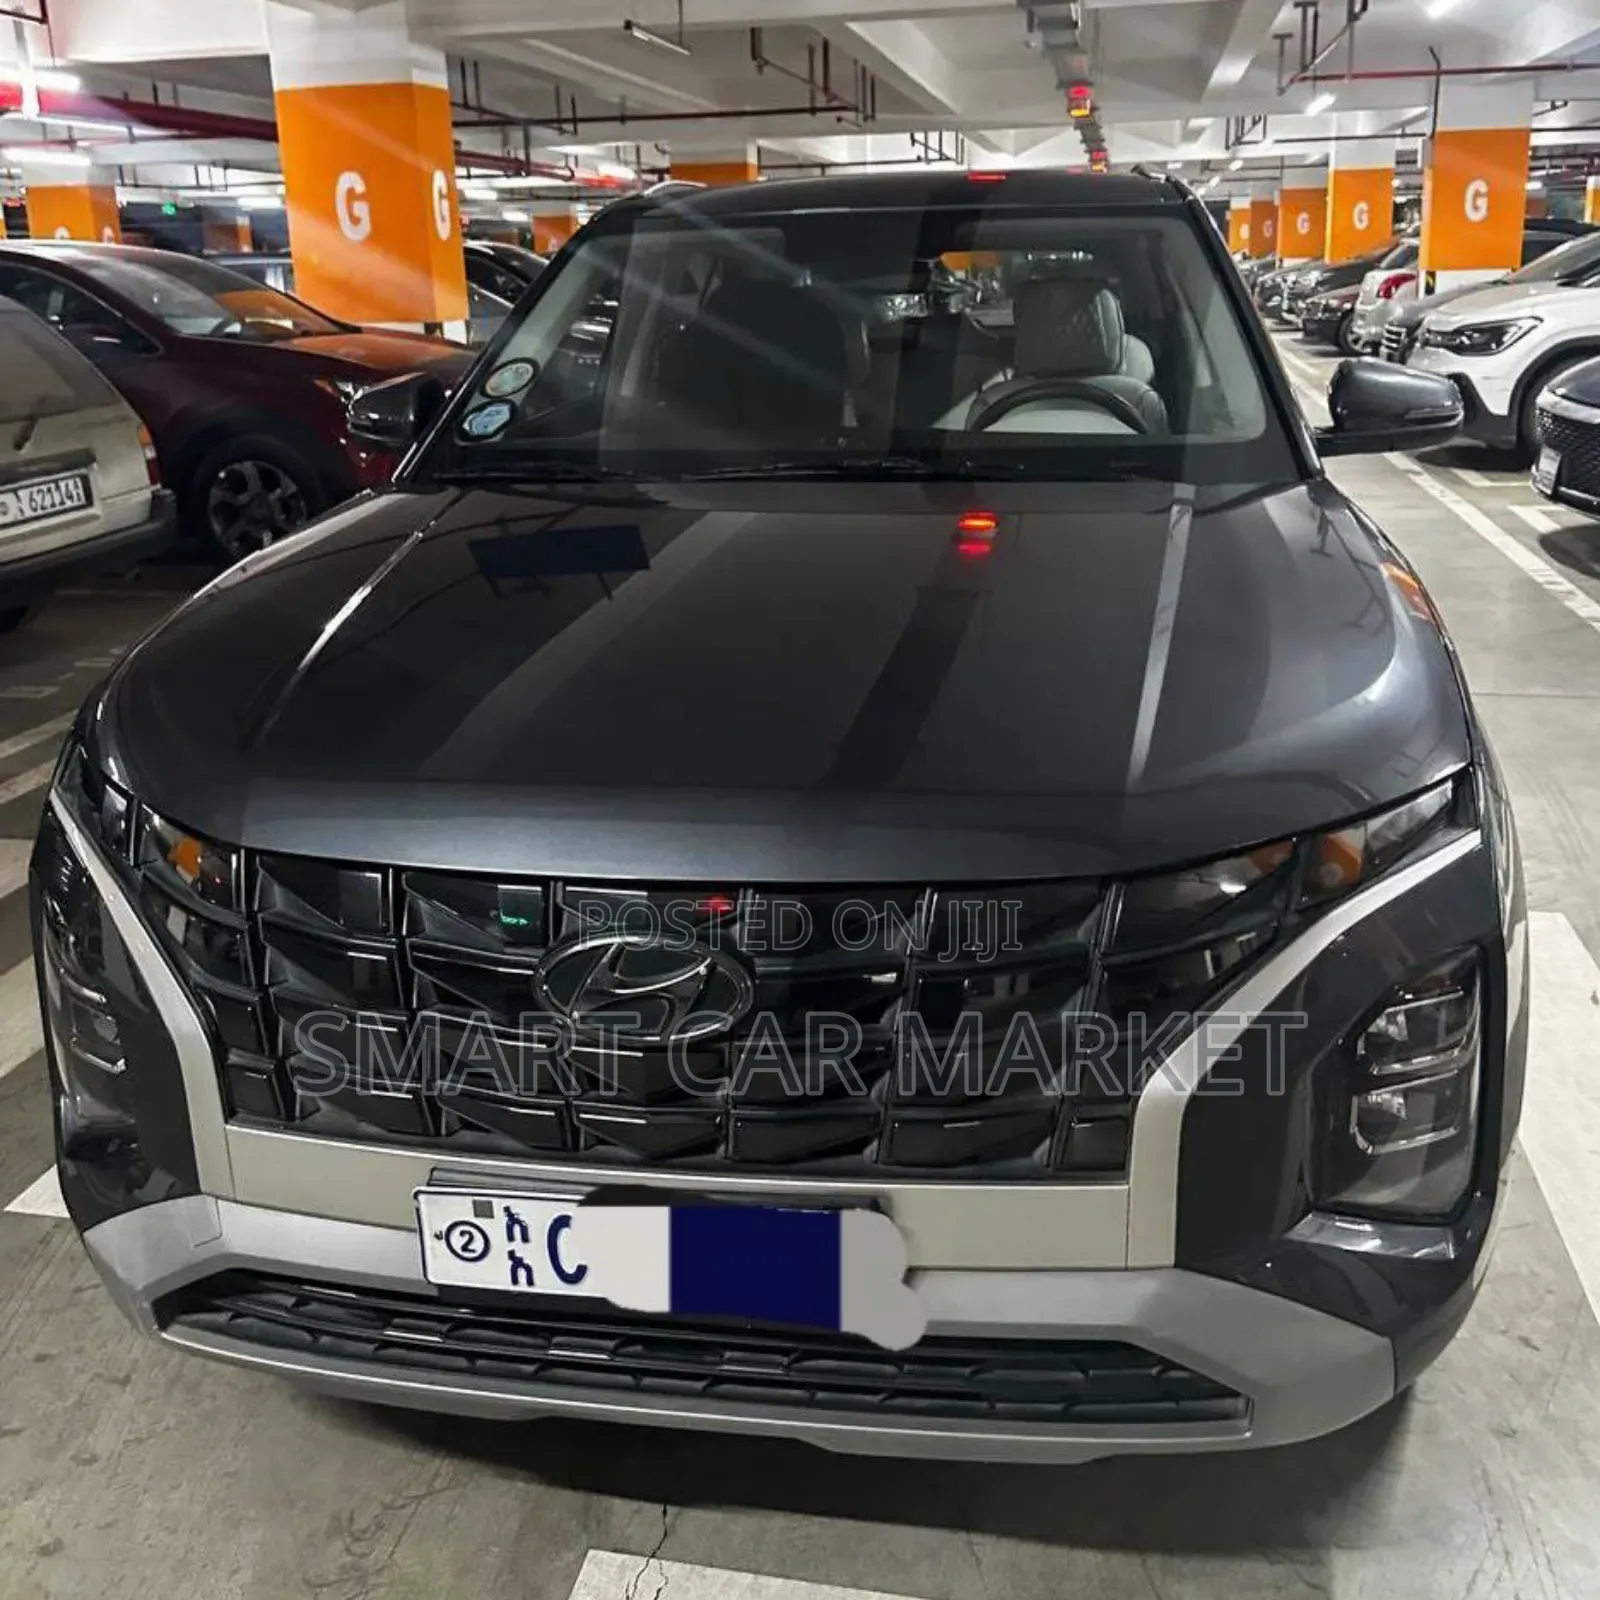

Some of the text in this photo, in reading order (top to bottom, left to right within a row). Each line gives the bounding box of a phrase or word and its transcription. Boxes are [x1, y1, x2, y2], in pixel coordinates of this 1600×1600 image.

[335, 171, 371, 243] G
[433, 169, 451, 242] G
[1353, 201, 1369, 230] G
[1465, 179, 1488, 222] G
[1297, 212, 1310, 235] G
[459, 1230, 477, 1254] 2
